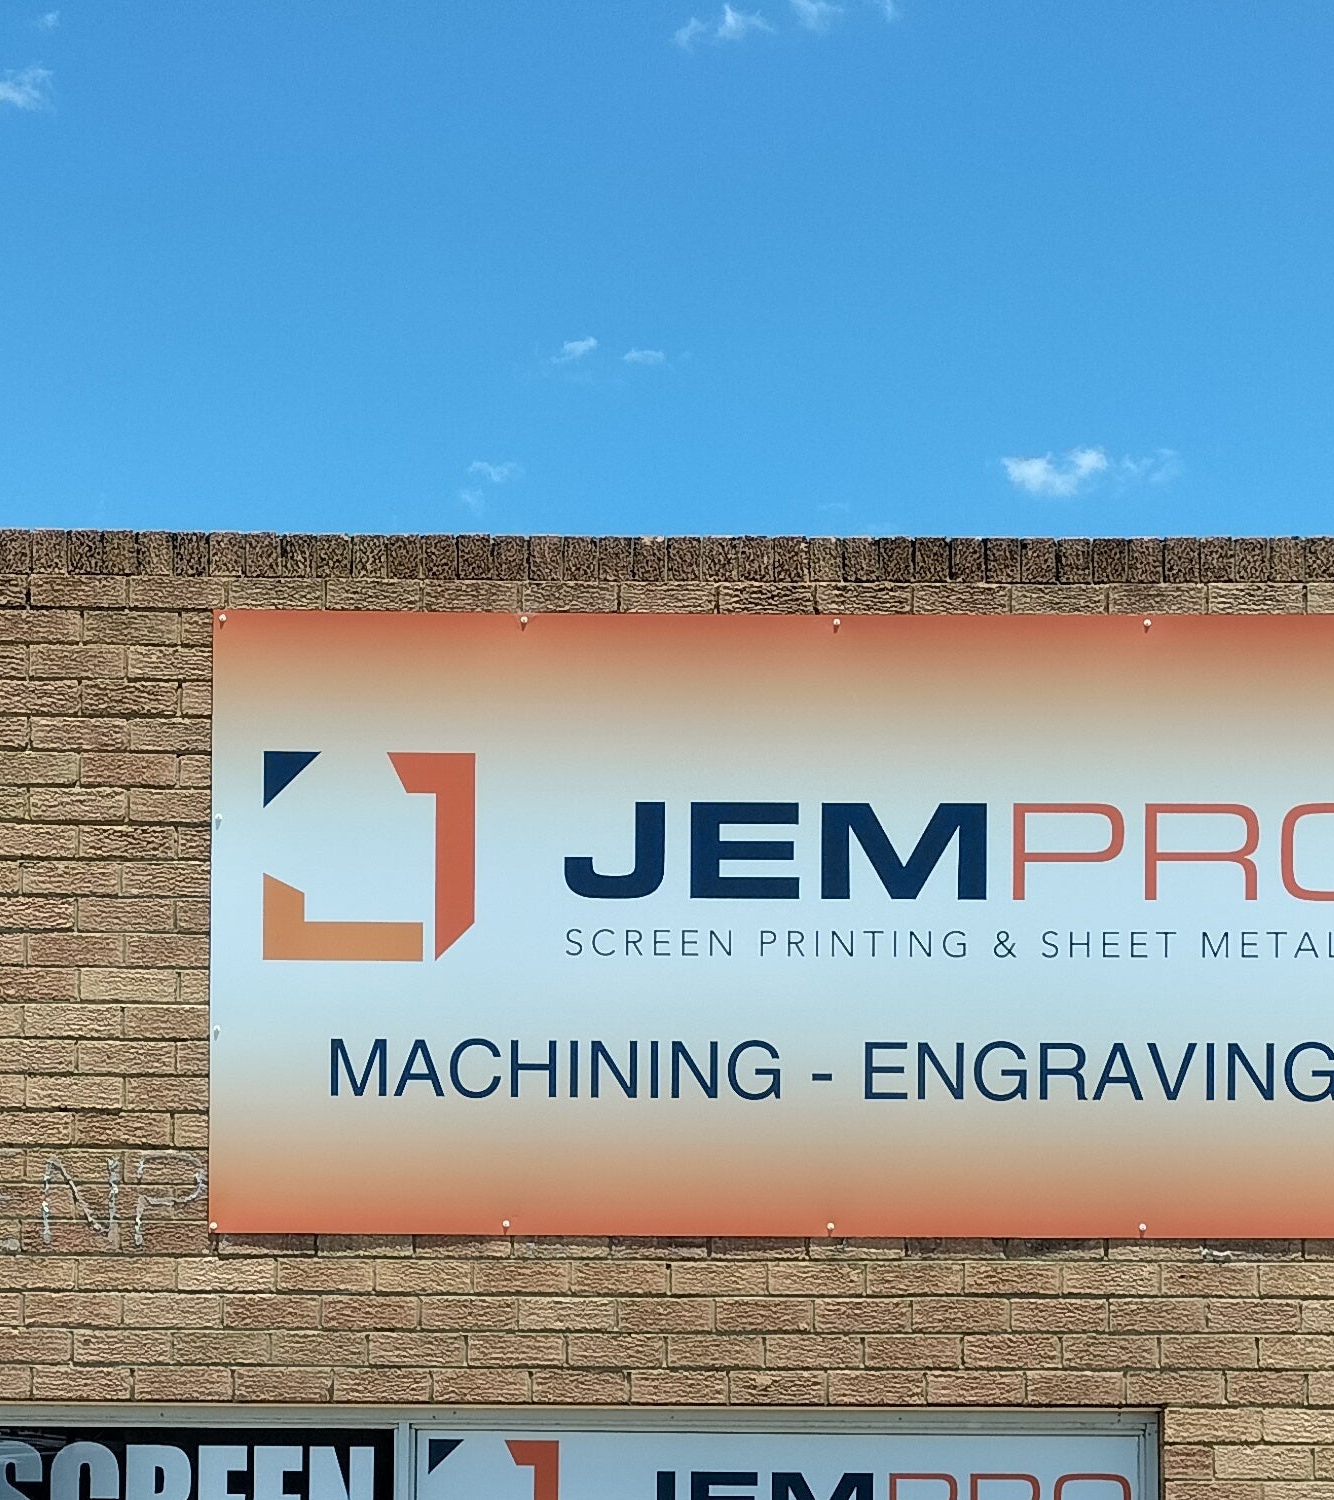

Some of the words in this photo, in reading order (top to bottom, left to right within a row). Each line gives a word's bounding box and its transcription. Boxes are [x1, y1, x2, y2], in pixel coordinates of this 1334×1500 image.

[566, 929, 731, 956] SCREEN
[761, 931, 966, 958] PRINTING
[994, 931, 1016, 958] &
[1042, 931, 1176, 958] SHEET
[331, 1038, 780, 1100] MACHINING
[812, 1073, 832, 1081] -
